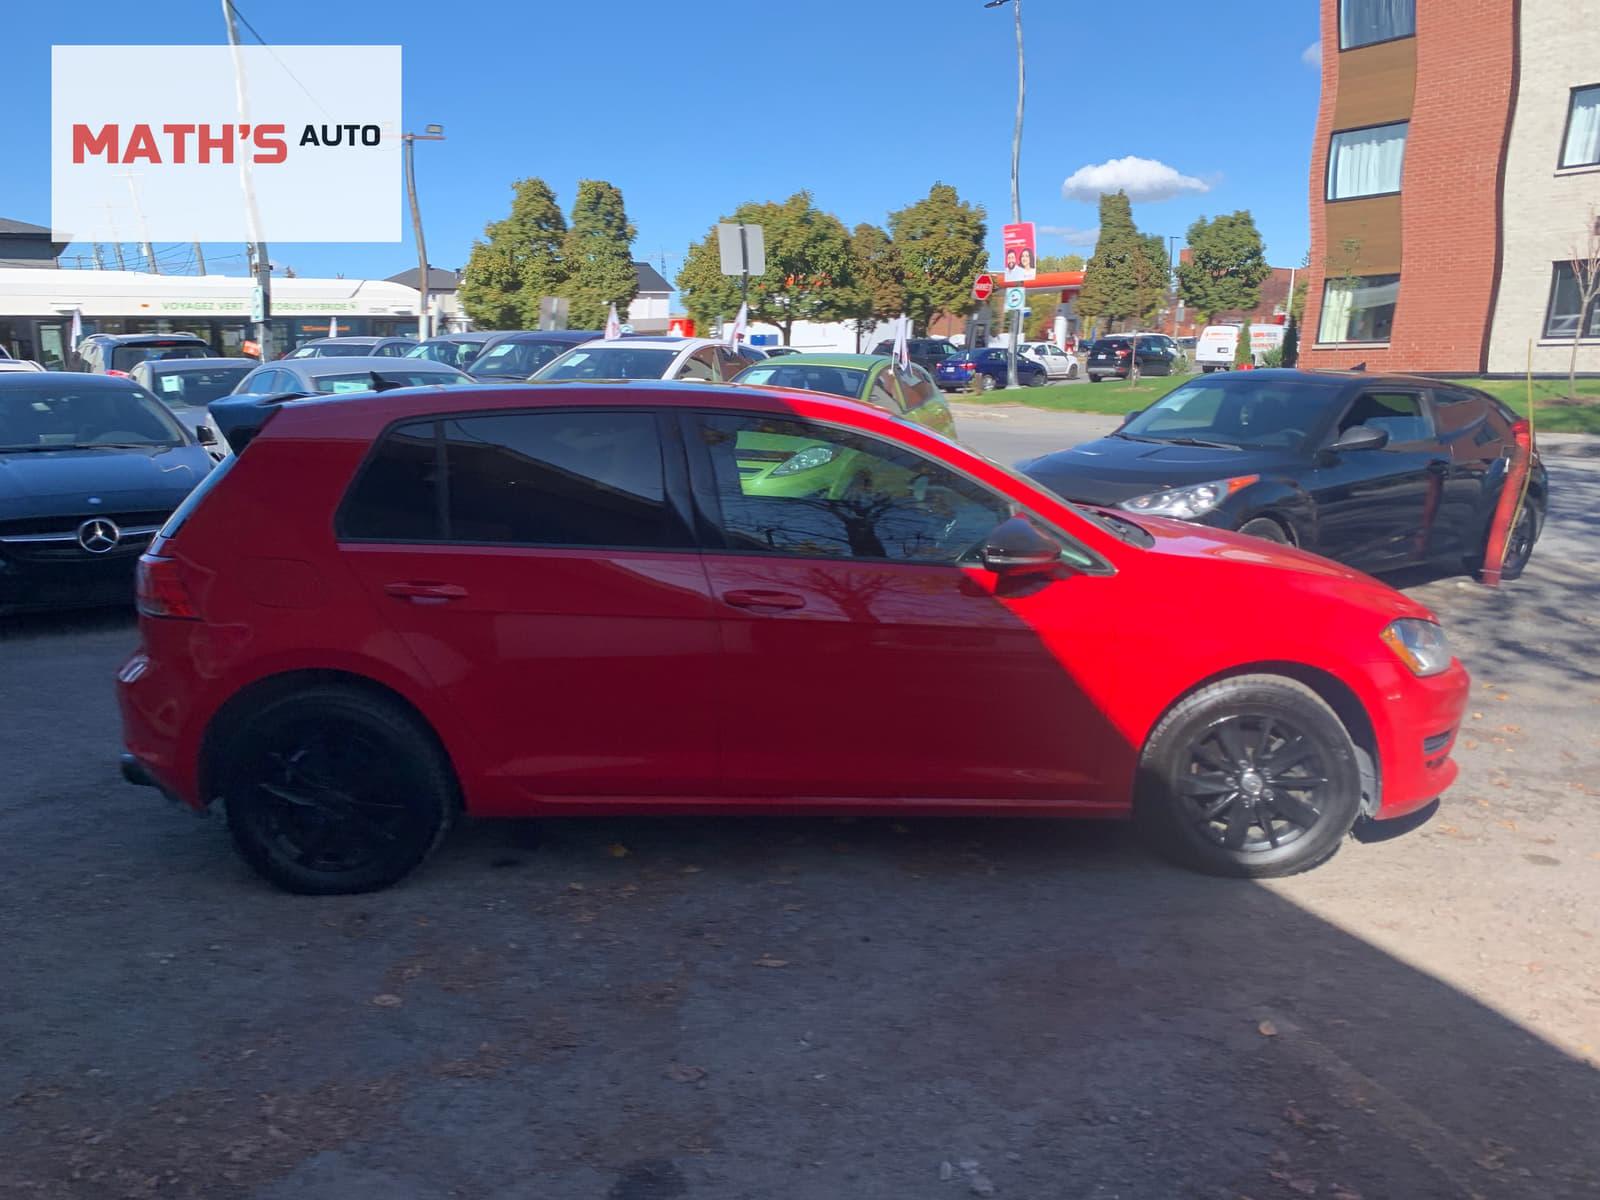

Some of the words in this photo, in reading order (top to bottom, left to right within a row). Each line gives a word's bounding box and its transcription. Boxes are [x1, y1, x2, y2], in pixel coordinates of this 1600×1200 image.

[161, 302, 214, 311] VOYAGEZ
[218, 302, 244, 311] VERT
[271, 302, 303, 311] TOBUS
[306, 302, 346, 311] HYBRIDE
